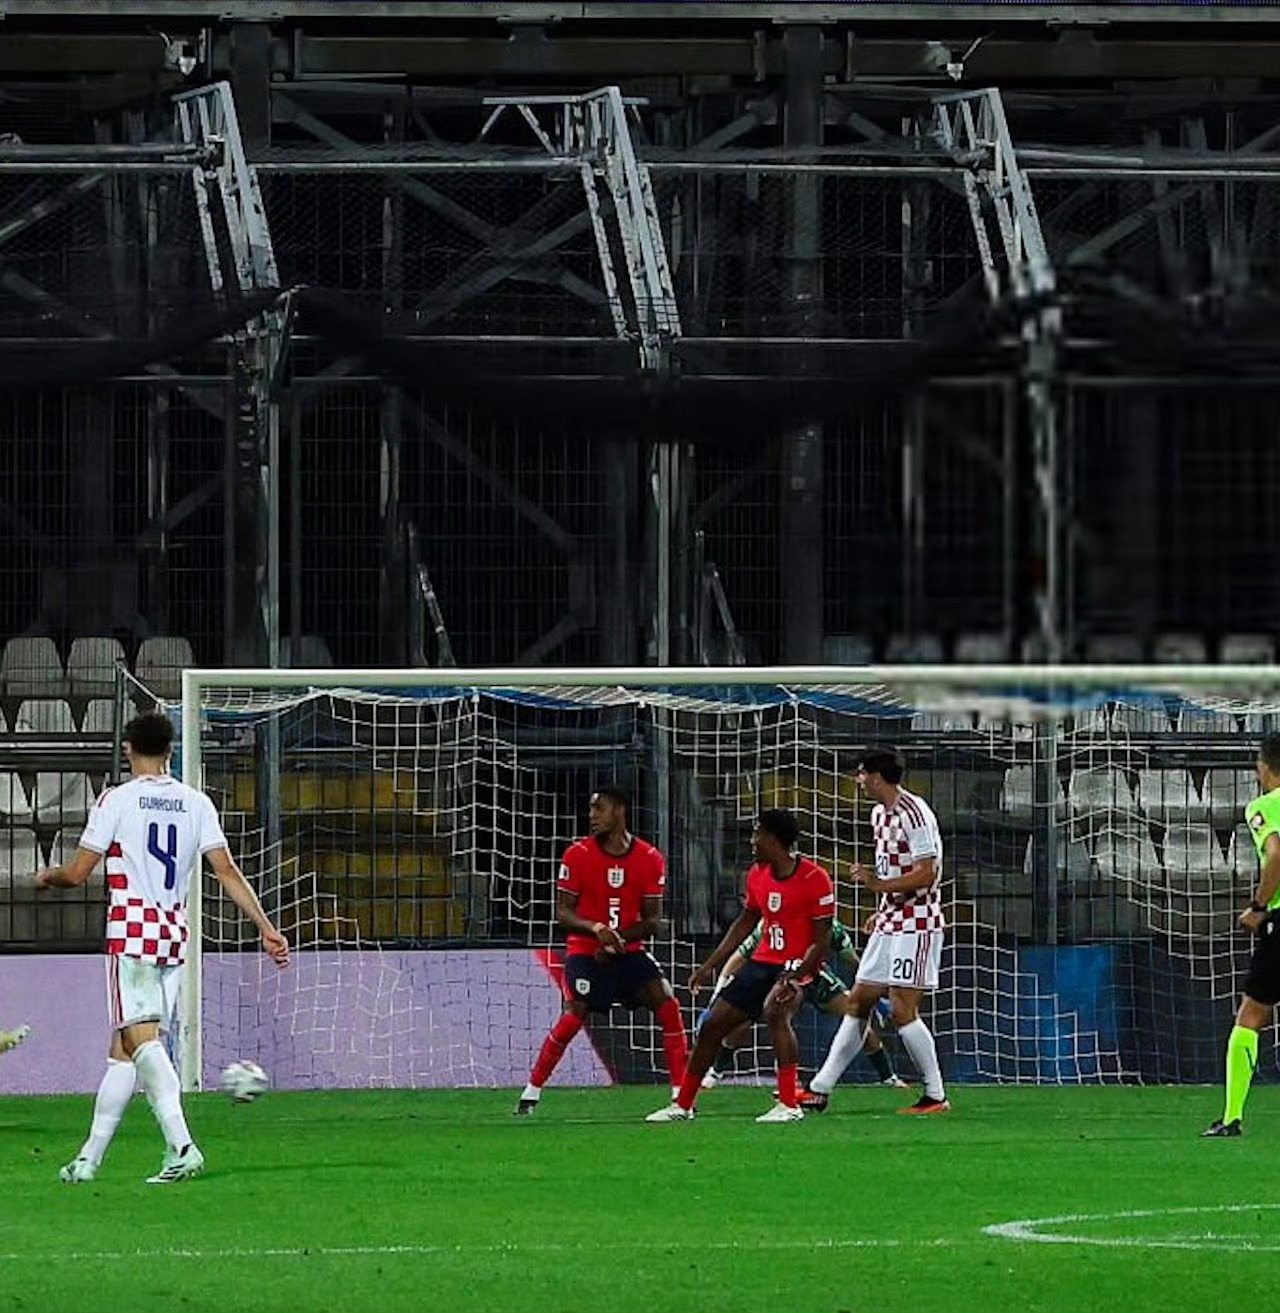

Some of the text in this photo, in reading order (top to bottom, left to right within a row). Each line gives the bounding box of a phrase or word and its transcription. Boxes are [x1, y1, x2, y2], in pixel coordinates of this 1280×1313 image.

[148, 822, 177, 890] 4
[877, 855, 889, 876] 20
[608, 907, 620, 930] 5
[768, 927, 785, 951] 16
[893, 958, 913, 980] 20
